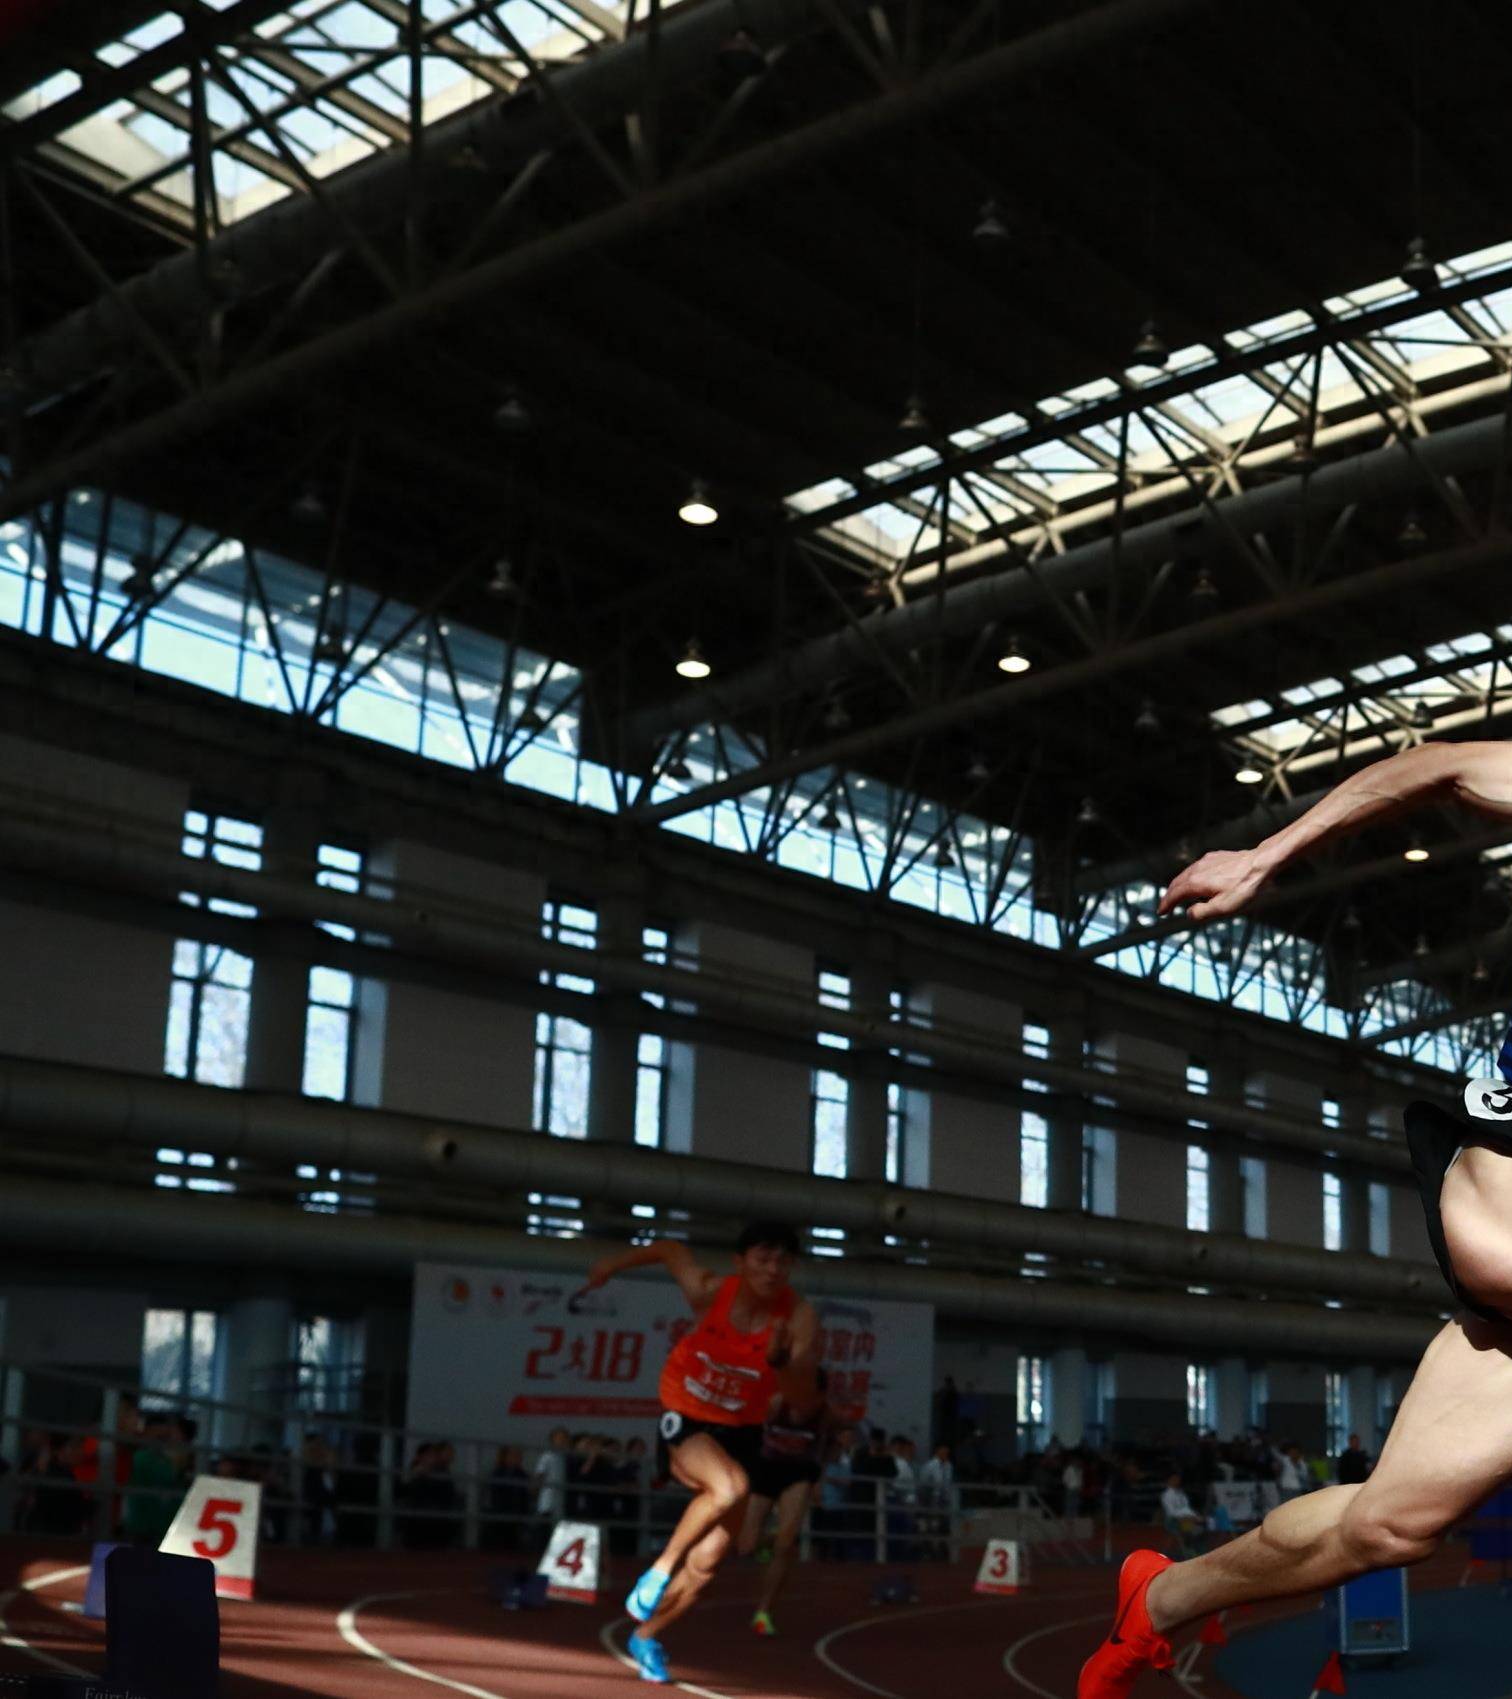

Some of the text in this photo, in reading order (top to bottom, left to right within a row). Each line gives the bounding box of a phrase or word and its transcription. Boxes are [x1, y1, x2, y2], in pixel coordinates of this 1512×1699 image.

[192, 1499, 243, 1558] 5
[555, 1537, 586, 1578] 4
[990, 1548, 1009, 1579] 3
